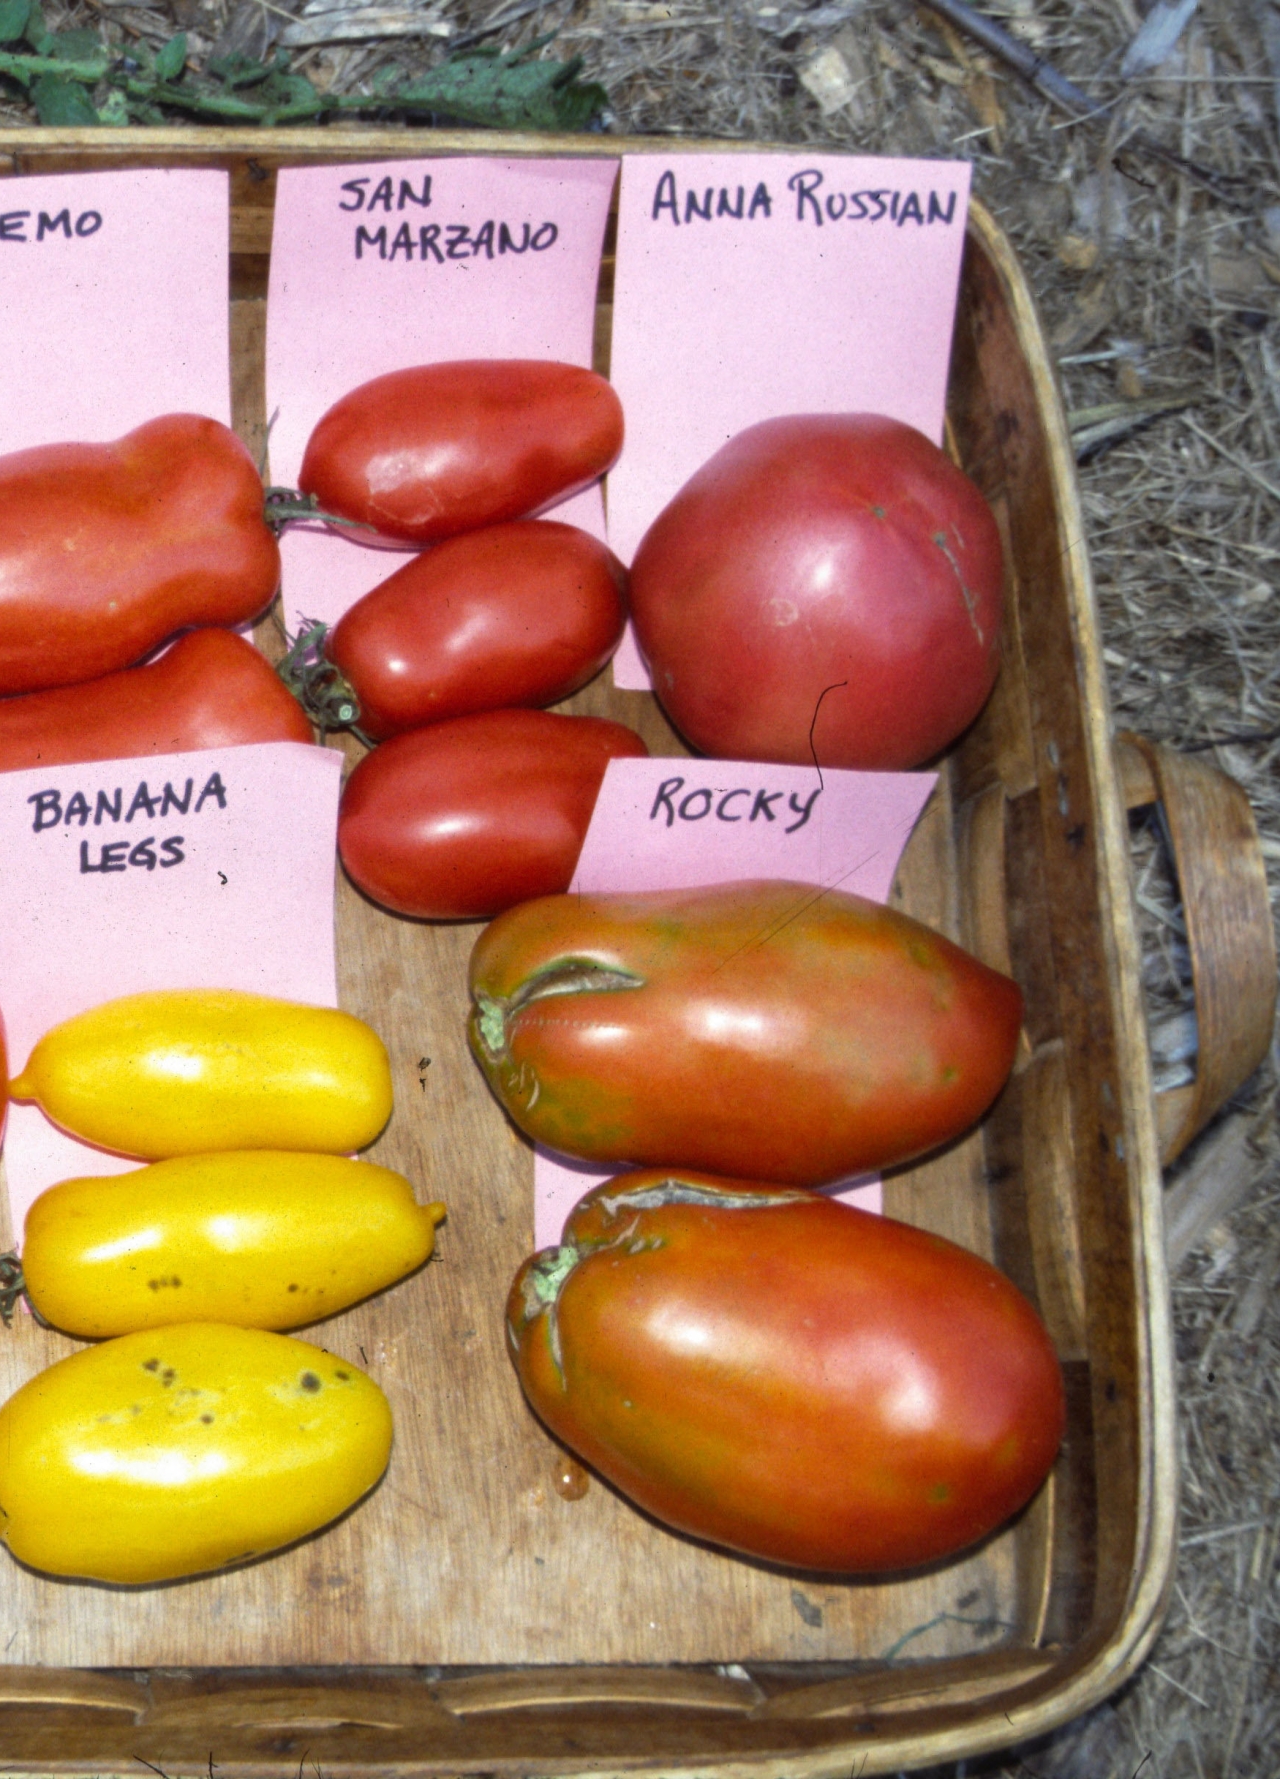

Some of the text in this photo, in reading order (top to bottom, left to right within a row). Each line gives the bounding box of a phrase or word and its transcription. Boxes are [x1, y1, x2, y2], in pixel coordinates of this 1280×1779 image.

[338, 174, 433, 213] SAN
[651, 170, 958, 226] ANNA RUSSIAN
[354, 220, 560, 264] MARZANO
[27, 772, 228, 834] BANANA
[649, 776, 825, 834] ROCKY
[79, 836, 187, 875] LEGS
